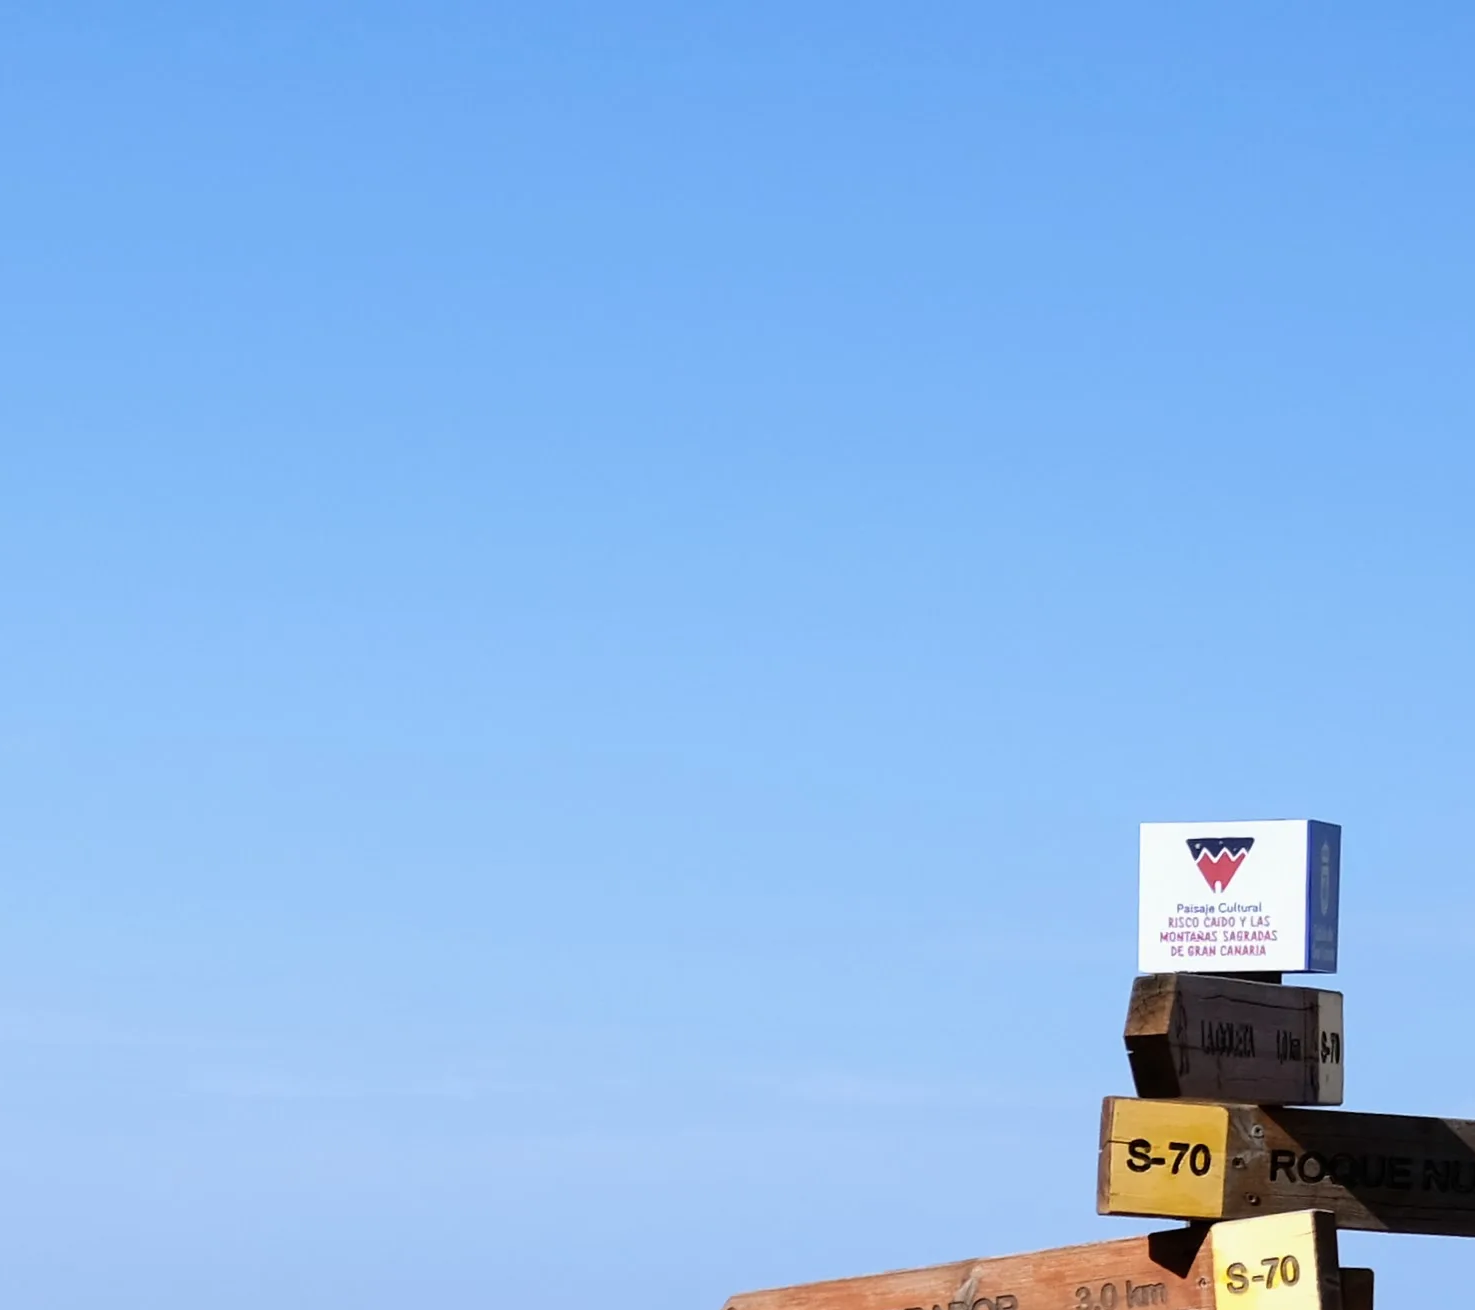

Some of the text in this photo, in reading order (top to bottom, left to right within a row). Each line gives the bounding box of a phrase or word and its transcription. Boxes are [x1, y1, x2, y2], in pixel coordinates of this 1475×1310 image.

[1177, 902, 1262, 915] Paisaje Cultural
[1168, 917, 1199, 928] RISCO
[1240, 916, 1247, 927] Y
[1250, 915, 1271, 927] LAS
[1223, 930, 1278, 942] SAGRADAS
[1171, 945, 1266, 957] DE GRAN CANARIA
[1321, 1031, 1340, 1063] S-70
[1126, 1138, 1211, 1176] S-70
[1269, 1149, 1412, 1190] ROQUE
[1126, 1280, 1168, 1310] km
[1226, 1255, 1300, 1294] S-70
